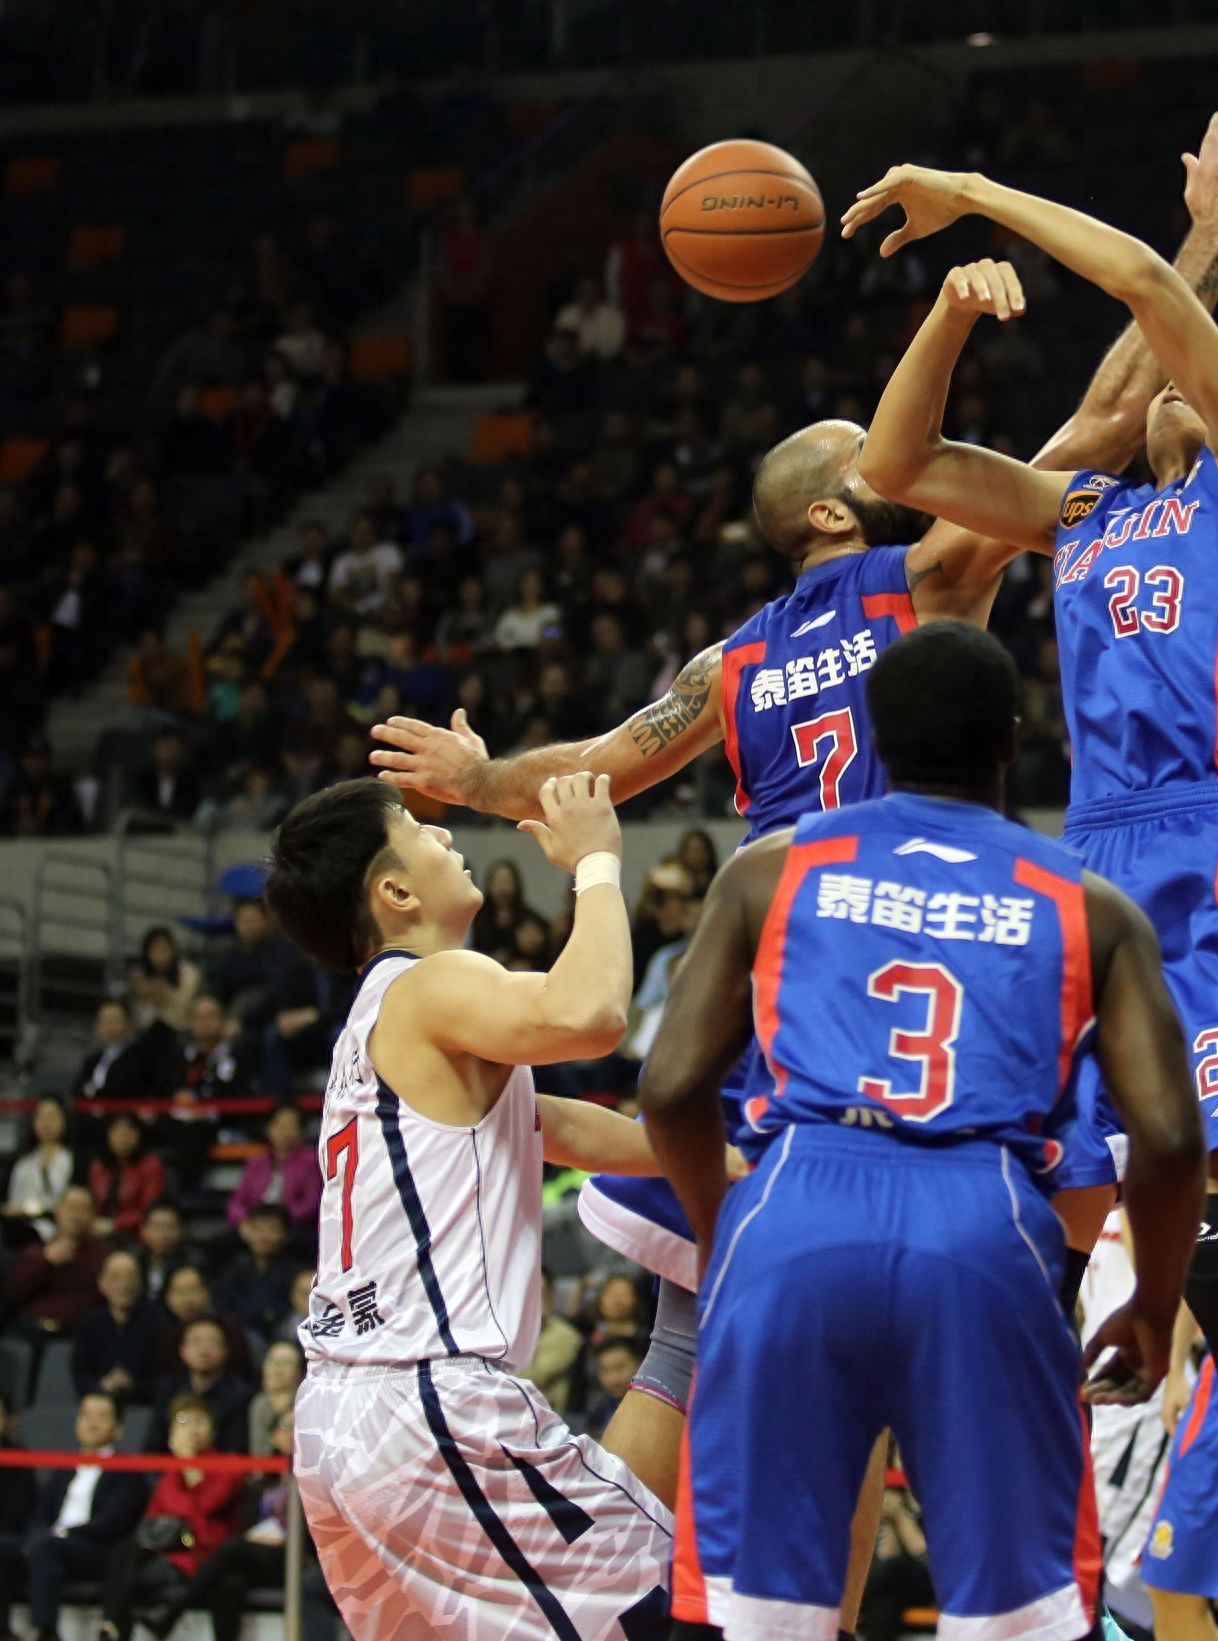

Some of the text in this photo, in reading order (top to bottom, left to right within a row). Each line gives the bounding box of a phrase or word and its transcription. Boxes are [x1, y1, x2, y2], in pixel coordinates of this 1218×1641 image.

[702, 196, 799, 211] LI-NING
[1063, 502, 1094, 523] ups
[1104, 565, 1184, 639] 23
[791, 706, 858, 812] 7
[857, 959, 964, 1123] 3
[326, 1114, 360, 1274] 7
